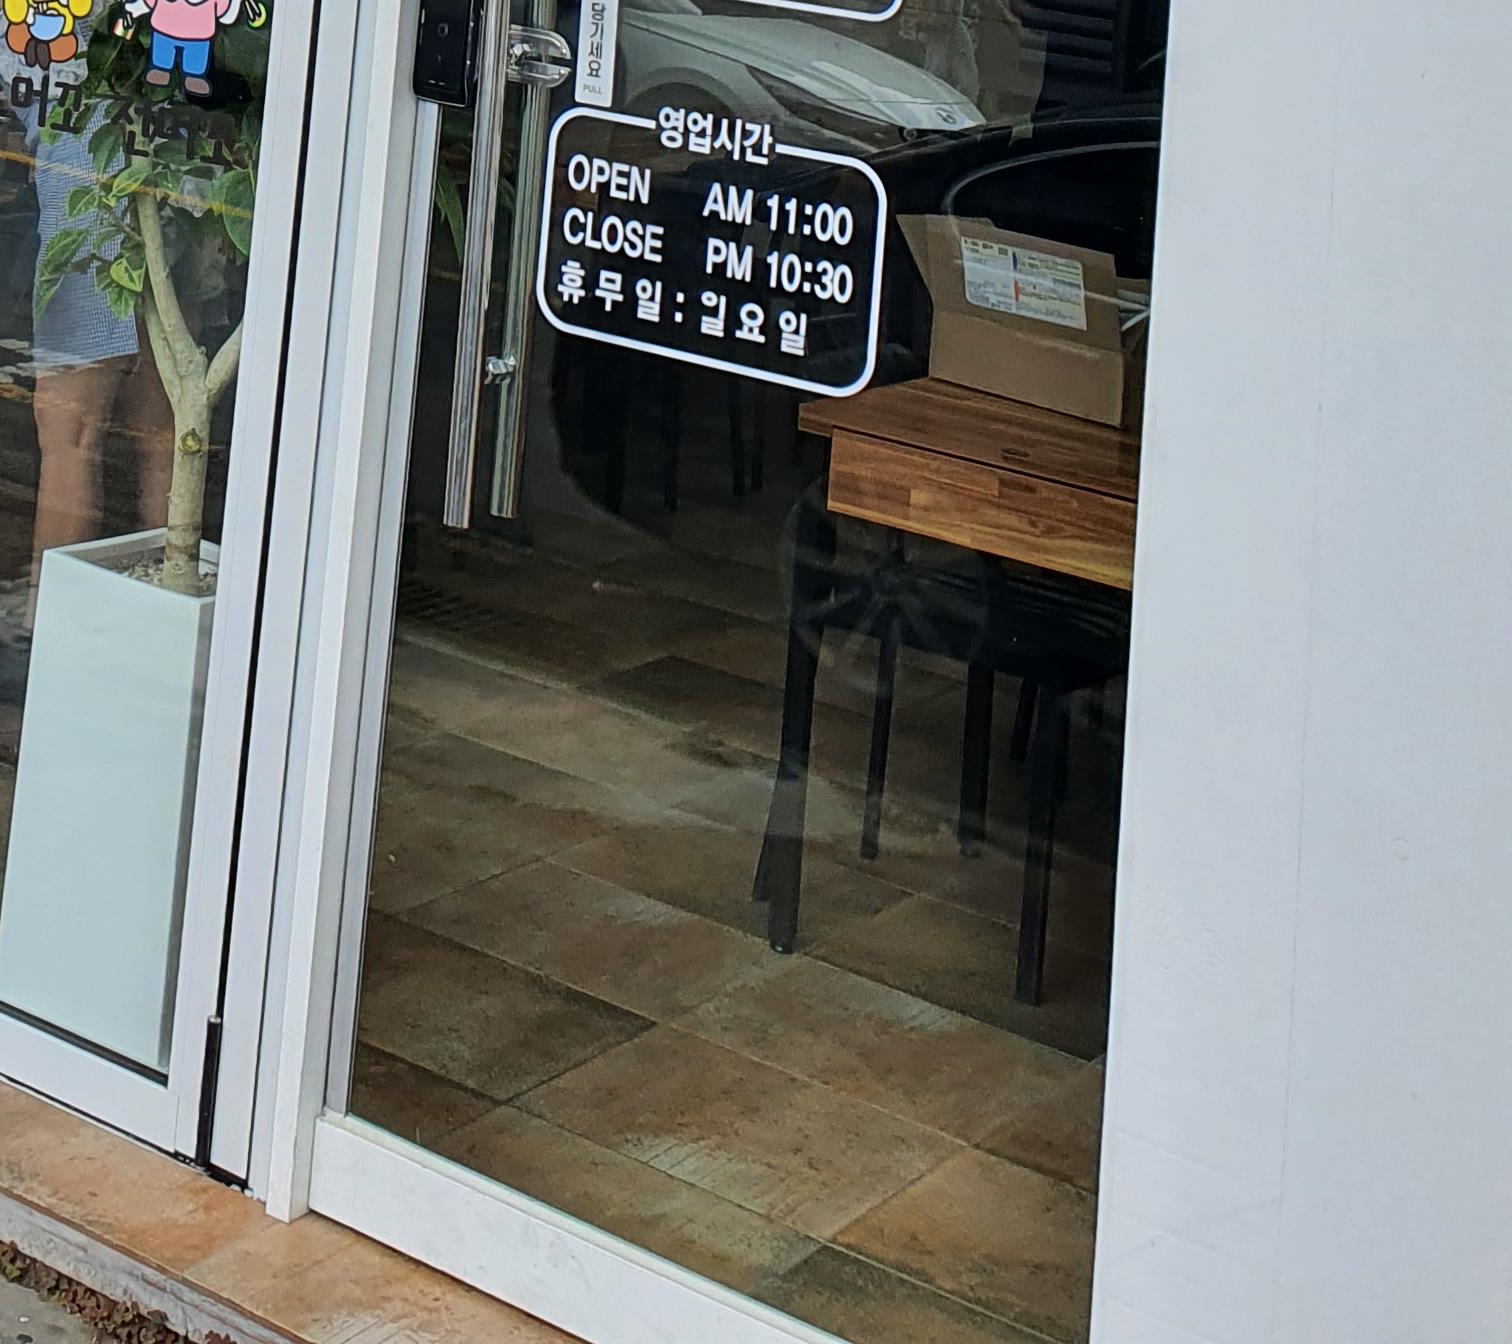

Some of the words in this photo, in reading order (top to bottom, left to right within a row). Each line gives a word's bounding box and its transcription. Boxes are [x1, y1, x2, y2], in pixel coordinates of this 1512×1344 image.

[587, 0, 607, 79] 당기세요
[581, 81, 605, 96] PULL
[655, 103, 775, 166] 영업시간
[567, 152, 652, 205] OPEN
[702, 181, 754, 226] AM
[766, 195, 854, 247] 11:00
[561, 207, 665, 264] CLOSE
[704, 237, 753, 284] PM
[766, 249, 855, 305] 10:30
